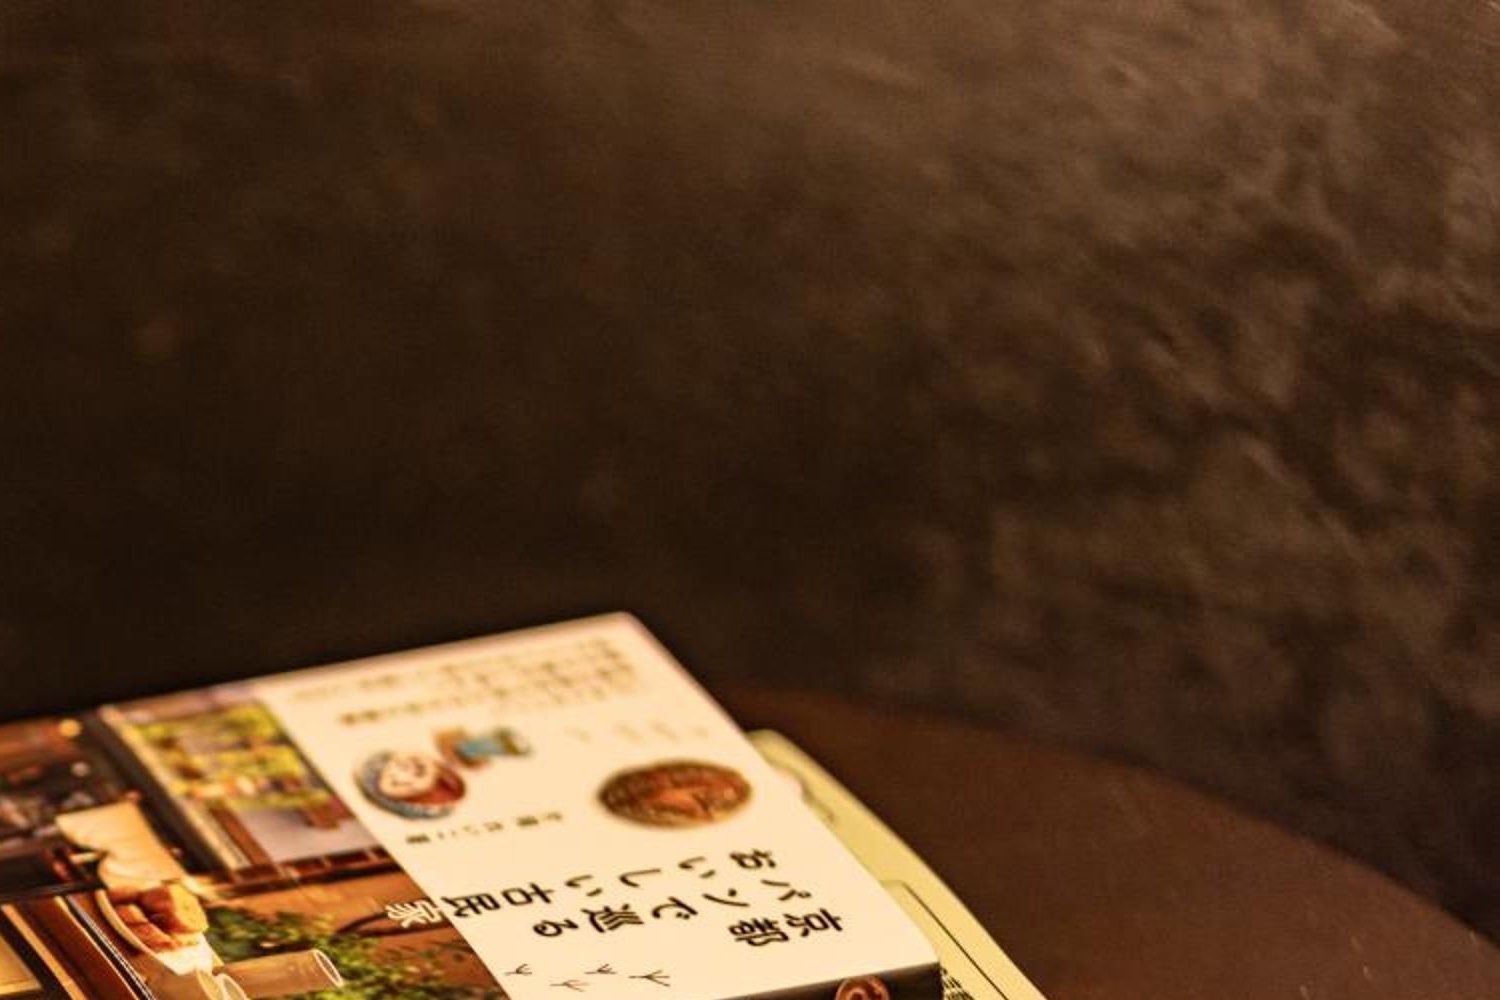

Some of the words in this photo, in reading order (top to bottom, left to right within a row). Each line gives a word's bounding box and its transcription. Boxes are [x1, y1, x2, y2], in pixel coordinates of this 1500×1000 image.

[386, 848, 779, 929] おいしい古民家
[533, 878, 813, 939] パンで巡る
[729, 907, 846, 947] 京都
